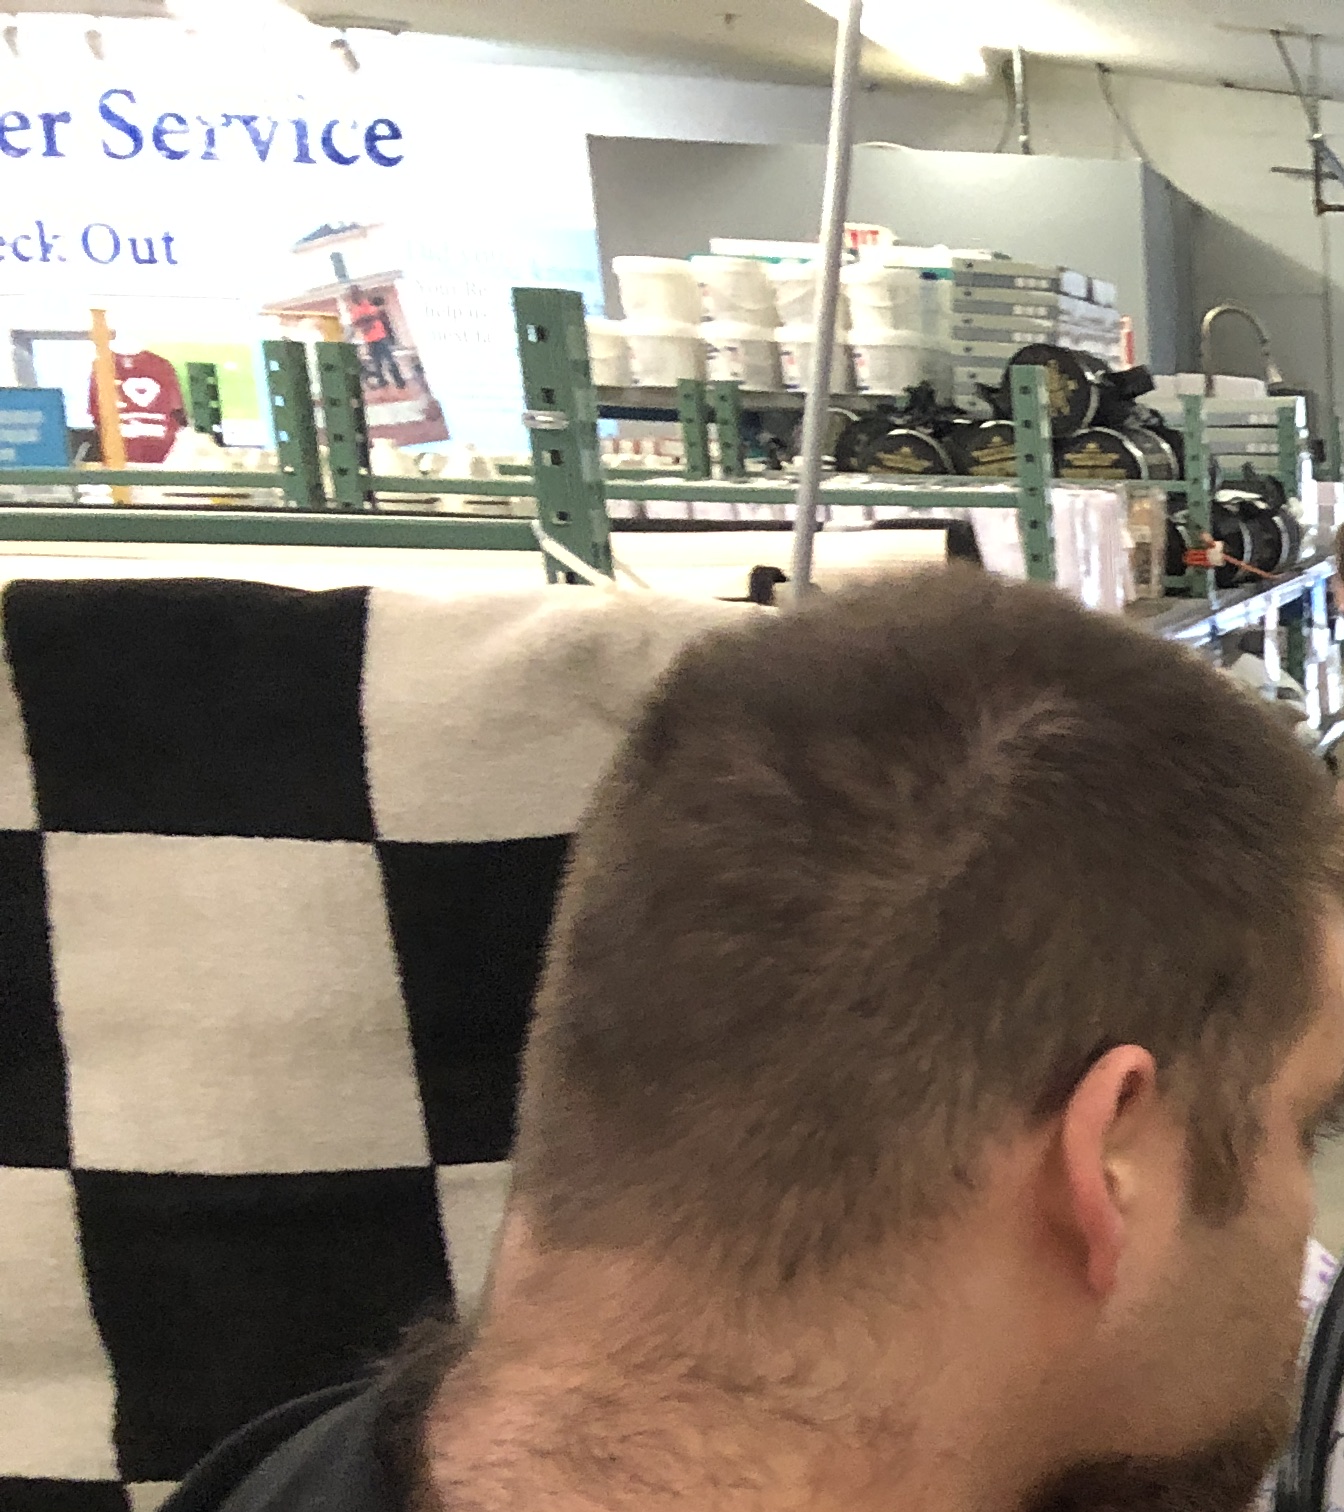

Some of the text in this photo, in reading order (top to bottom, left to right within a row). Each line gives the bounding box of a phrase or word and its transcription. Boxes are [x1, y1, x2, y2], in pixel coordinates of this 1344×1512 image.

[0, 88, 405, 168] er Service
[81, 222, 179, 265] Out
